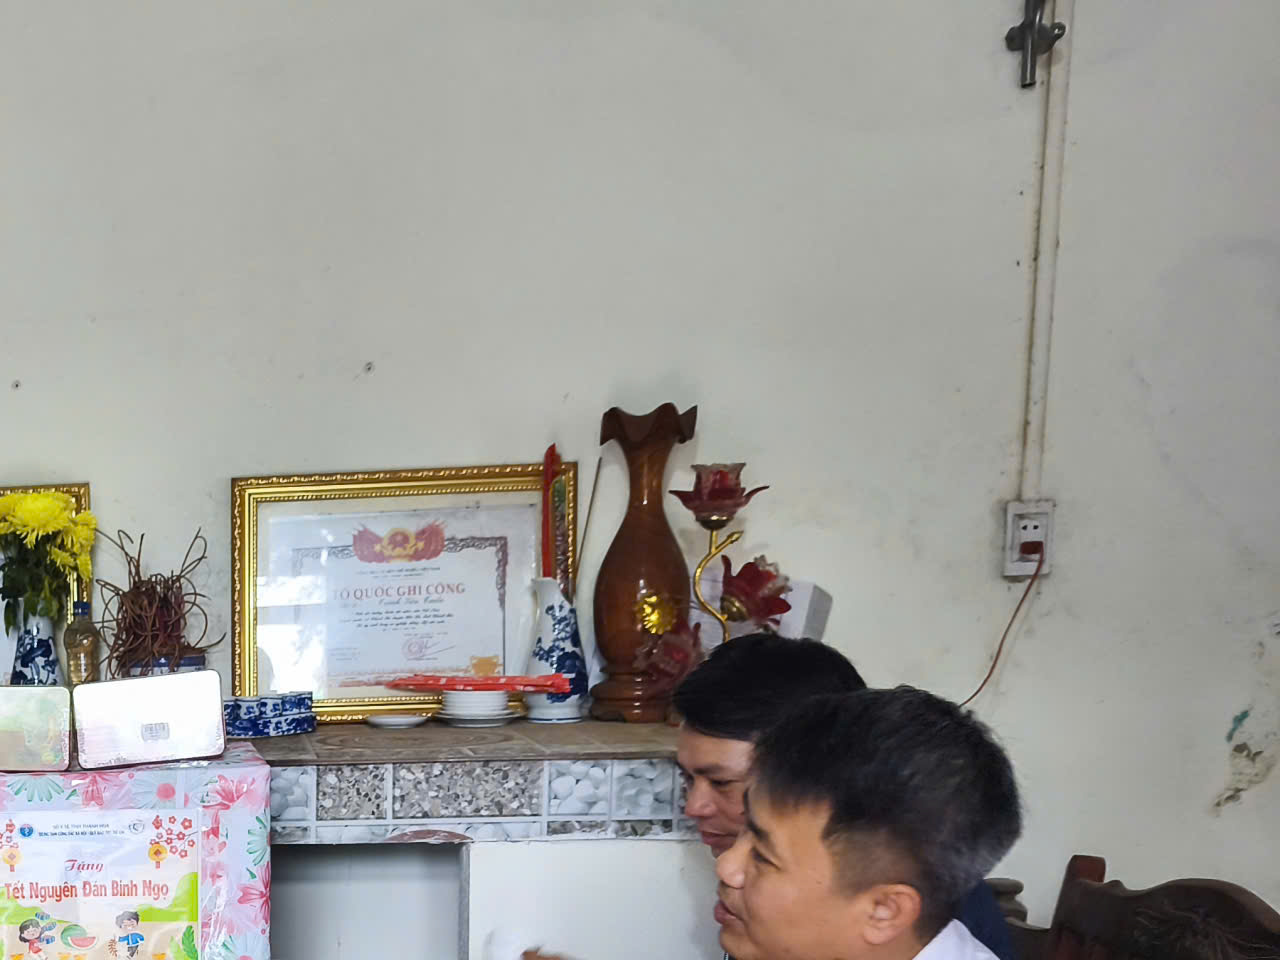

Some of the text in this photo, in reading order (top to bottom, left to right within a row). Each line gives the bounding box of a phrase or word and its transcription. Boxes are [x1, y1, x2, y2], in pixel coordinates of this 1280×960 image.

[396, 584, 422, 597] GHI
[426, 581, 466, 595] CÔNG
[65, 859, 104, 873] Tặng
[4, 881, 26, 900] Tết
[29, 880, 78, 902] Nguyên
[82, 879, 107, 897] Đán
[142, 879, 169, 901] Ngọ
